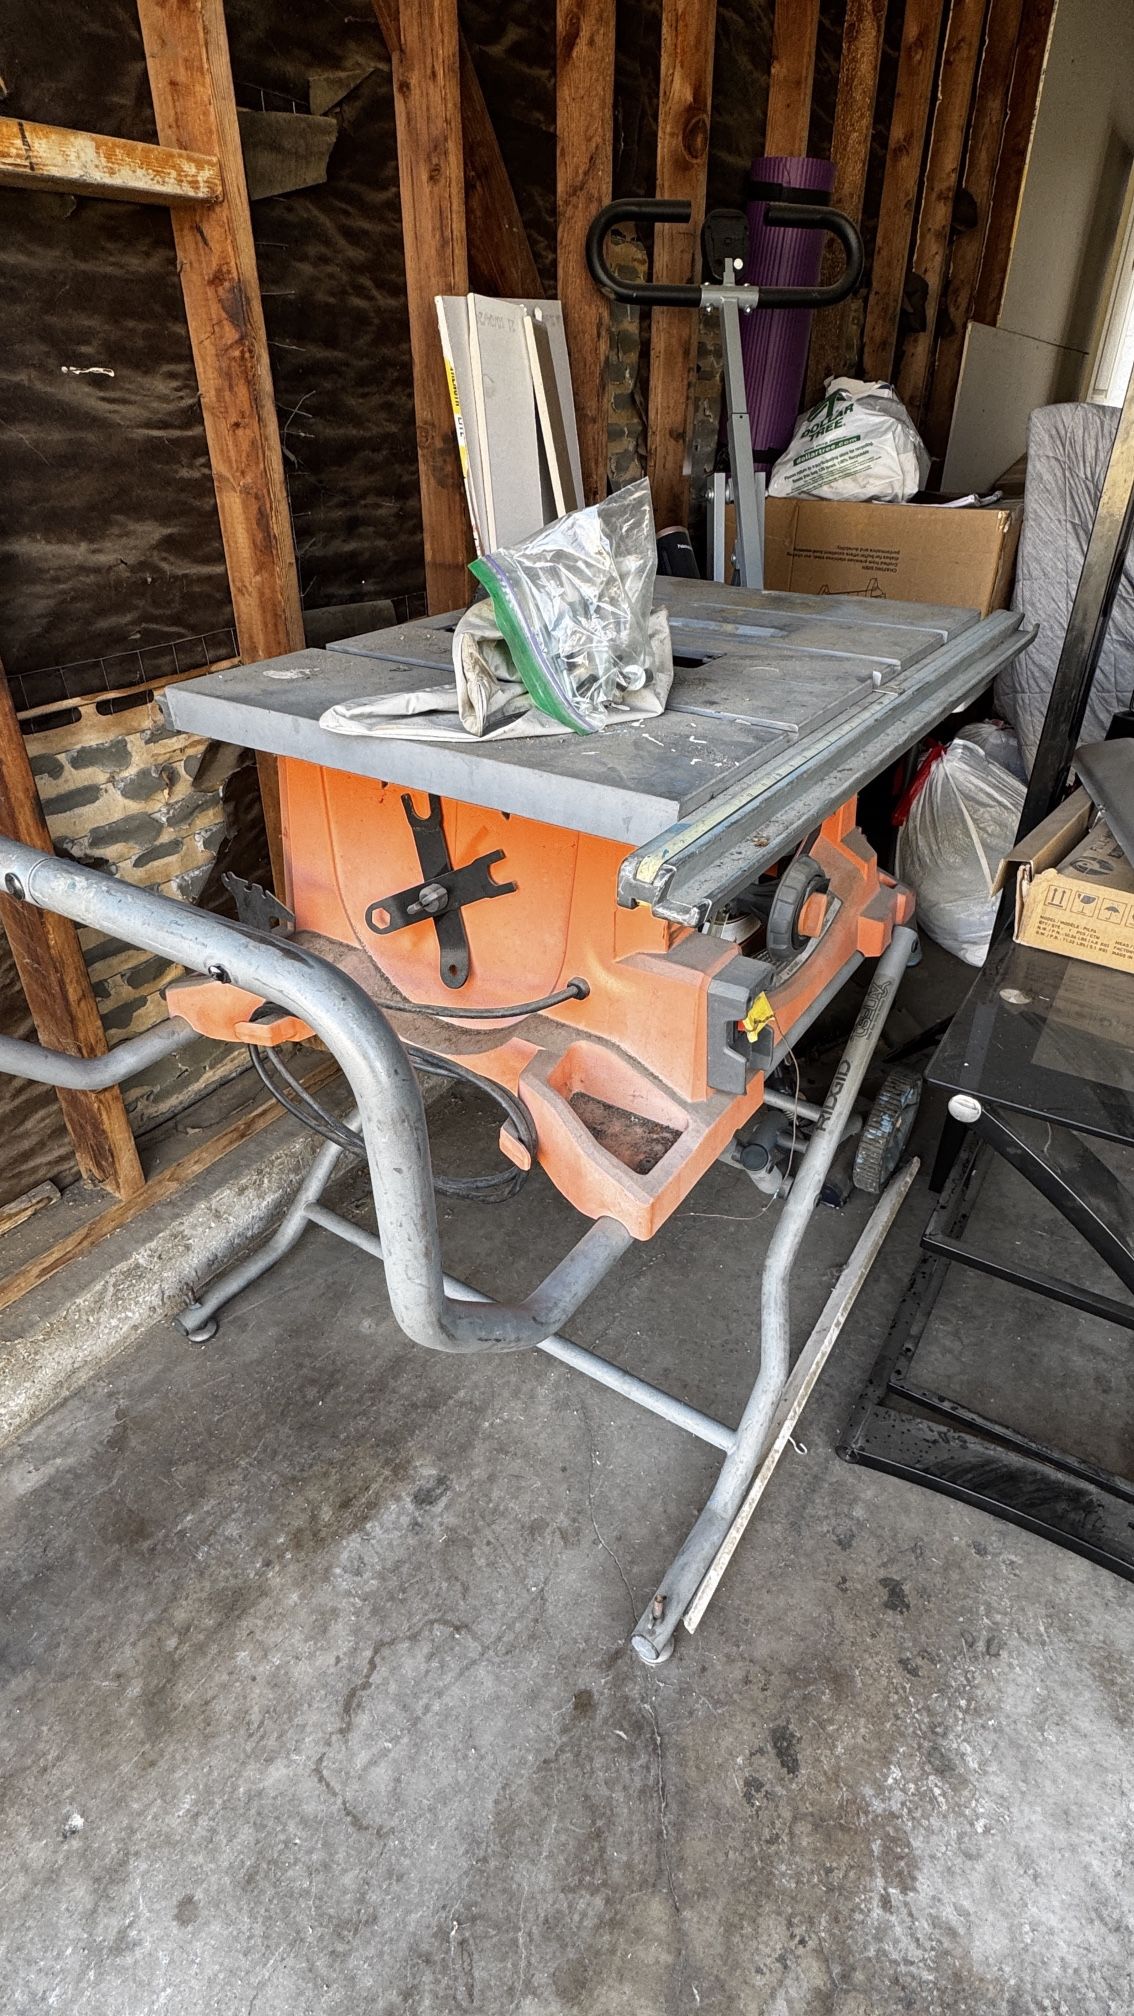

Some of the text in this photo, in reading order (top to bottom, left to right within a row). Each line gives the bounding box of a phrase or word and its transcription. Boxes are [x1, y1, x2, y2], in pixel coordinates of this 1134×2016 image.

[801, 403, 854, 439] DOLLAR
[809, 417, 844, 441] TREE
[795, 437, 857, 465] dollartree.com
[815, 1060, 852, 1131] RIDGID
